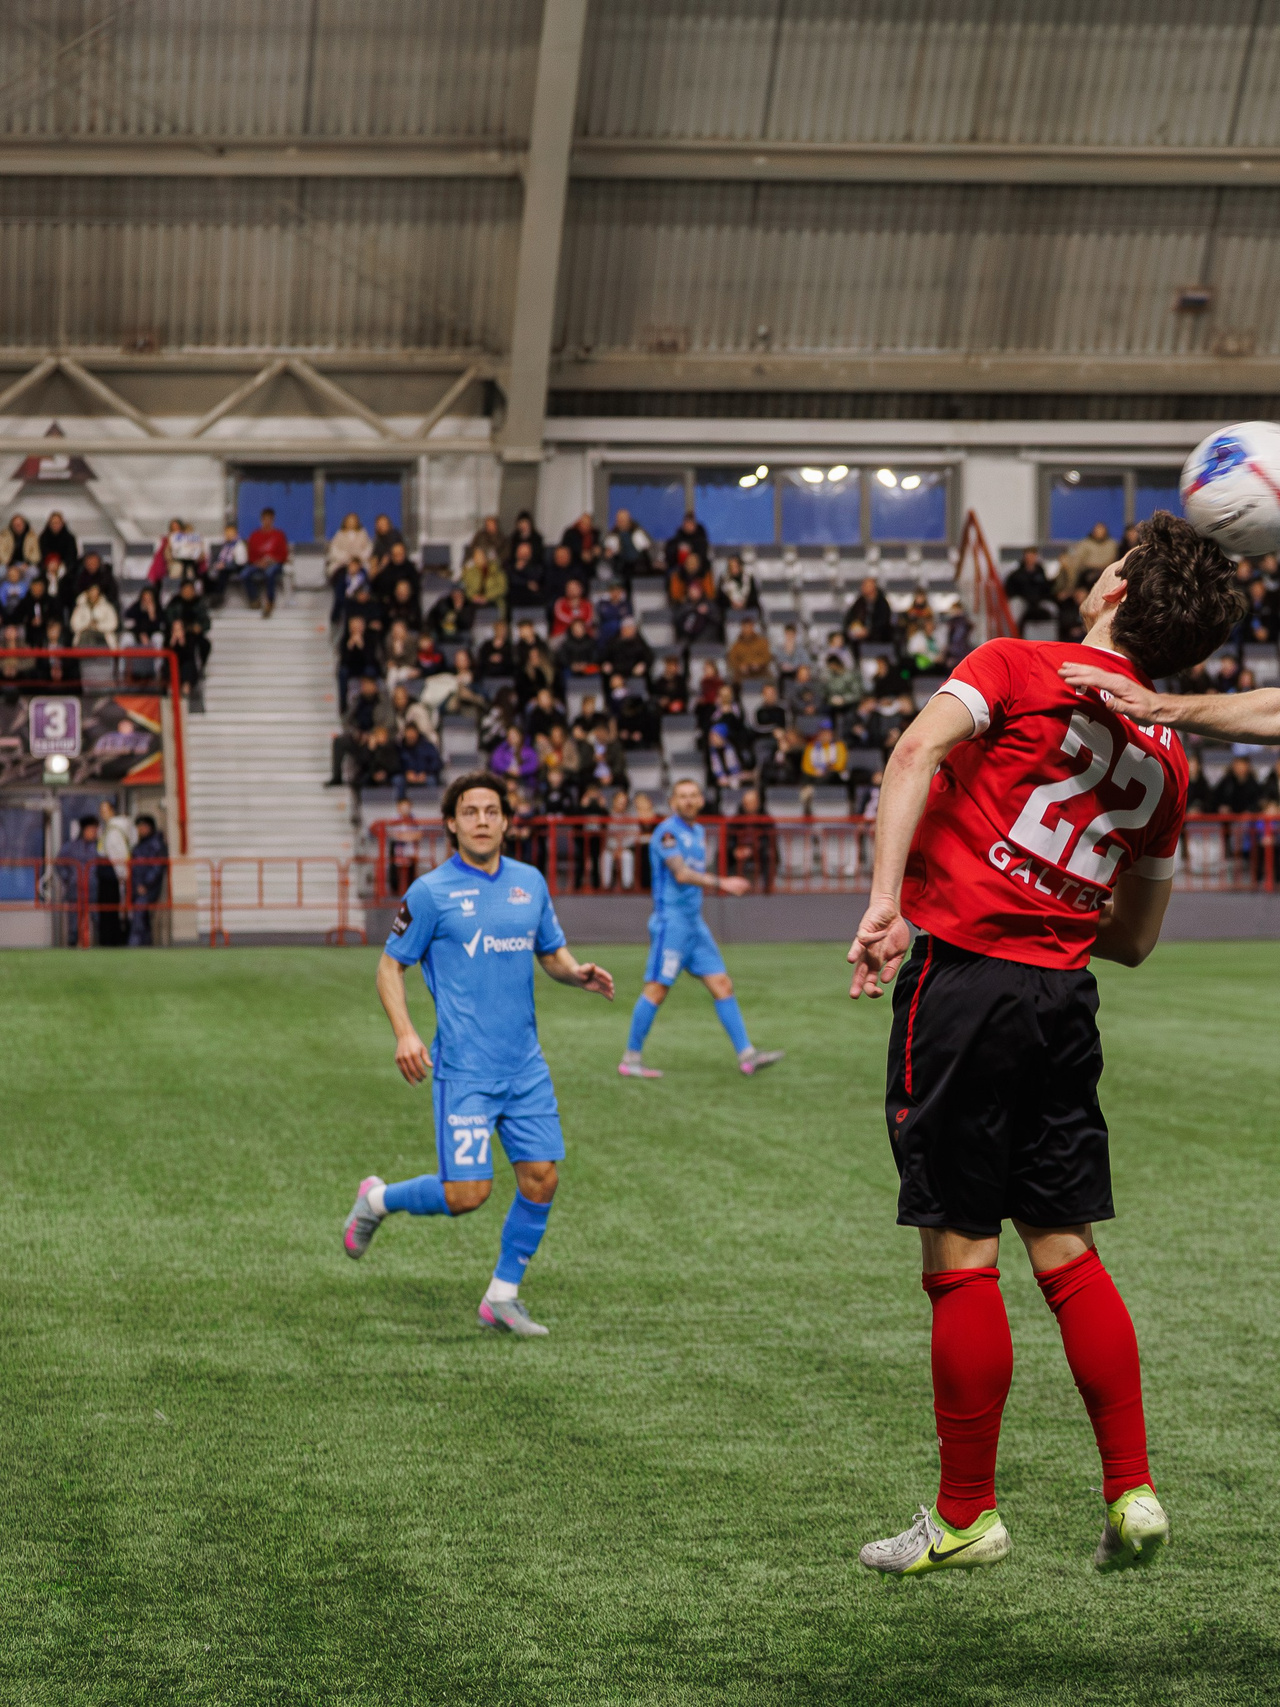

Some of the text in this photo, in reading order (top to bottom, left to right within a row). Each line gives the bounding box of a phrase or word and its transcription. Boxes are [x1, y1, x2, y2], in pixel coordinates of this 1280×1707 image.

[43, 701, 68, 739] 3
[1008, 709, 1164, 885] 22
[453, 1127, 490, 1166] 27
